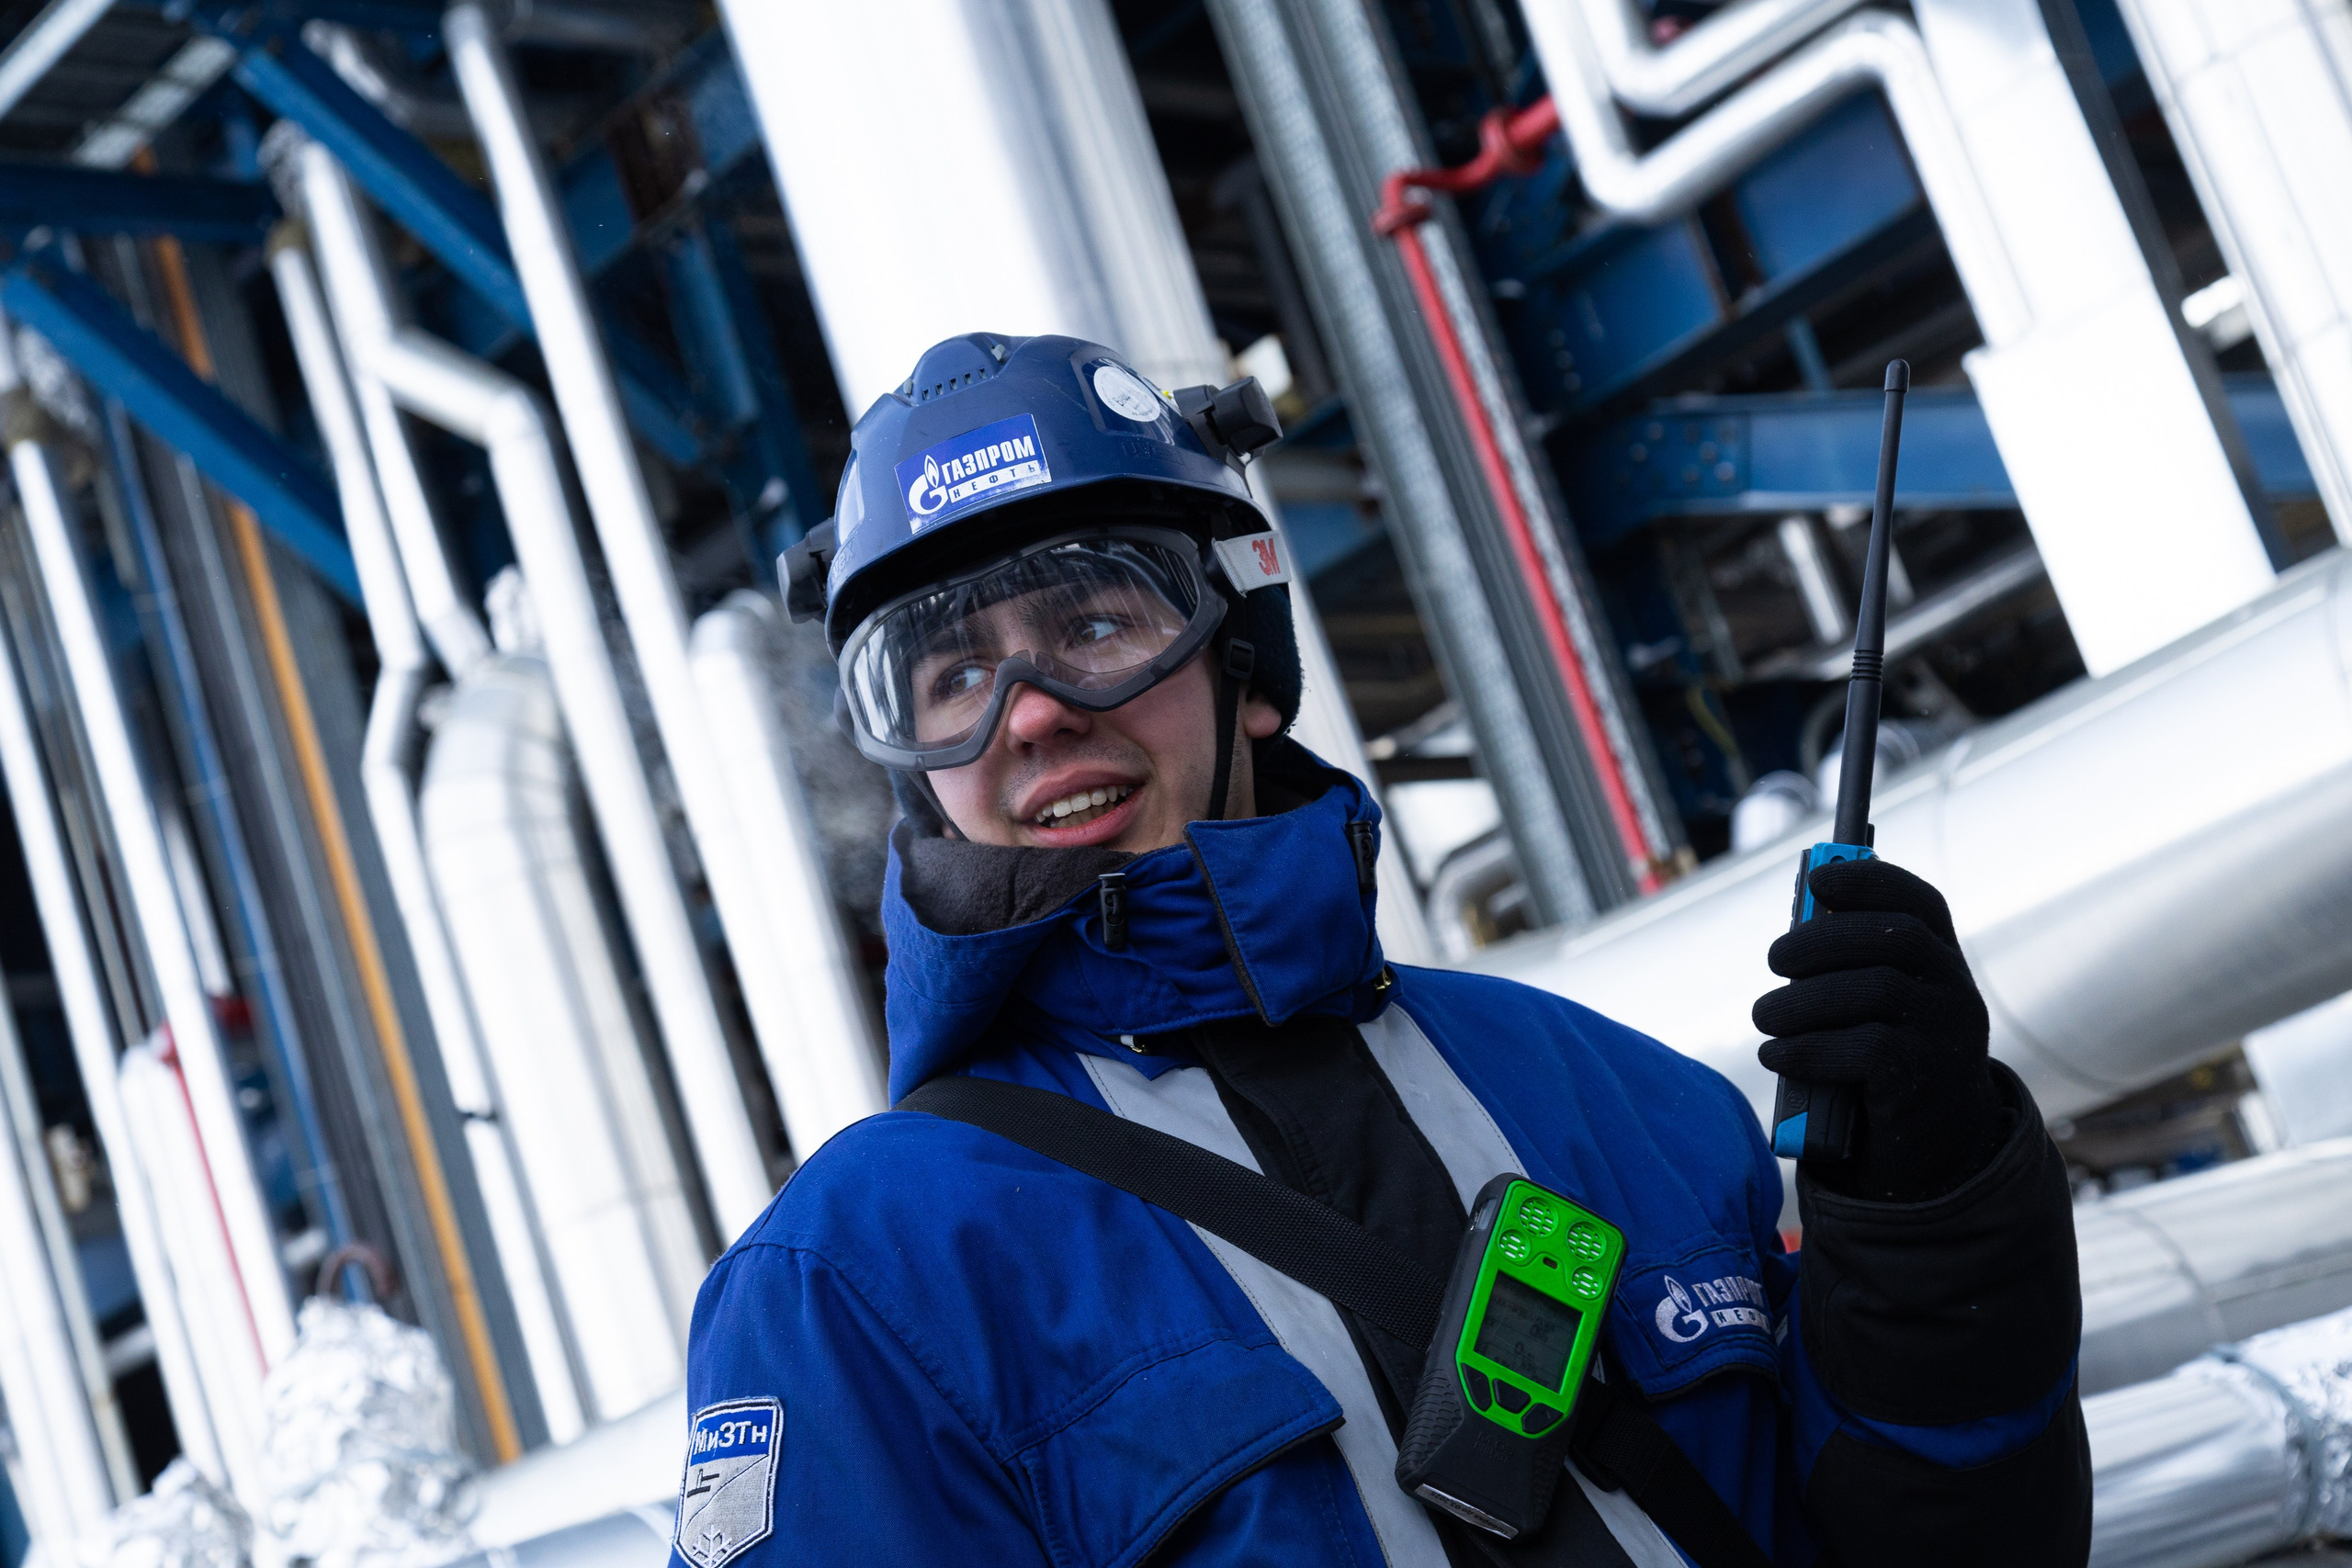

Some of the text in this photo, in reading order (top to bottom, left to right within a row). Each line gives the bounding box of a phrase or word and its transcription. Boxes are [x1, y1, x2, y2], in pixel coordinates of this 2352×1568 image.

[942, 435, 1035, 484] ГАЗПРОМ
[954, 465, 1035, 499] НЕФТЬ
[1252, 538, 1281, 576] 3M
